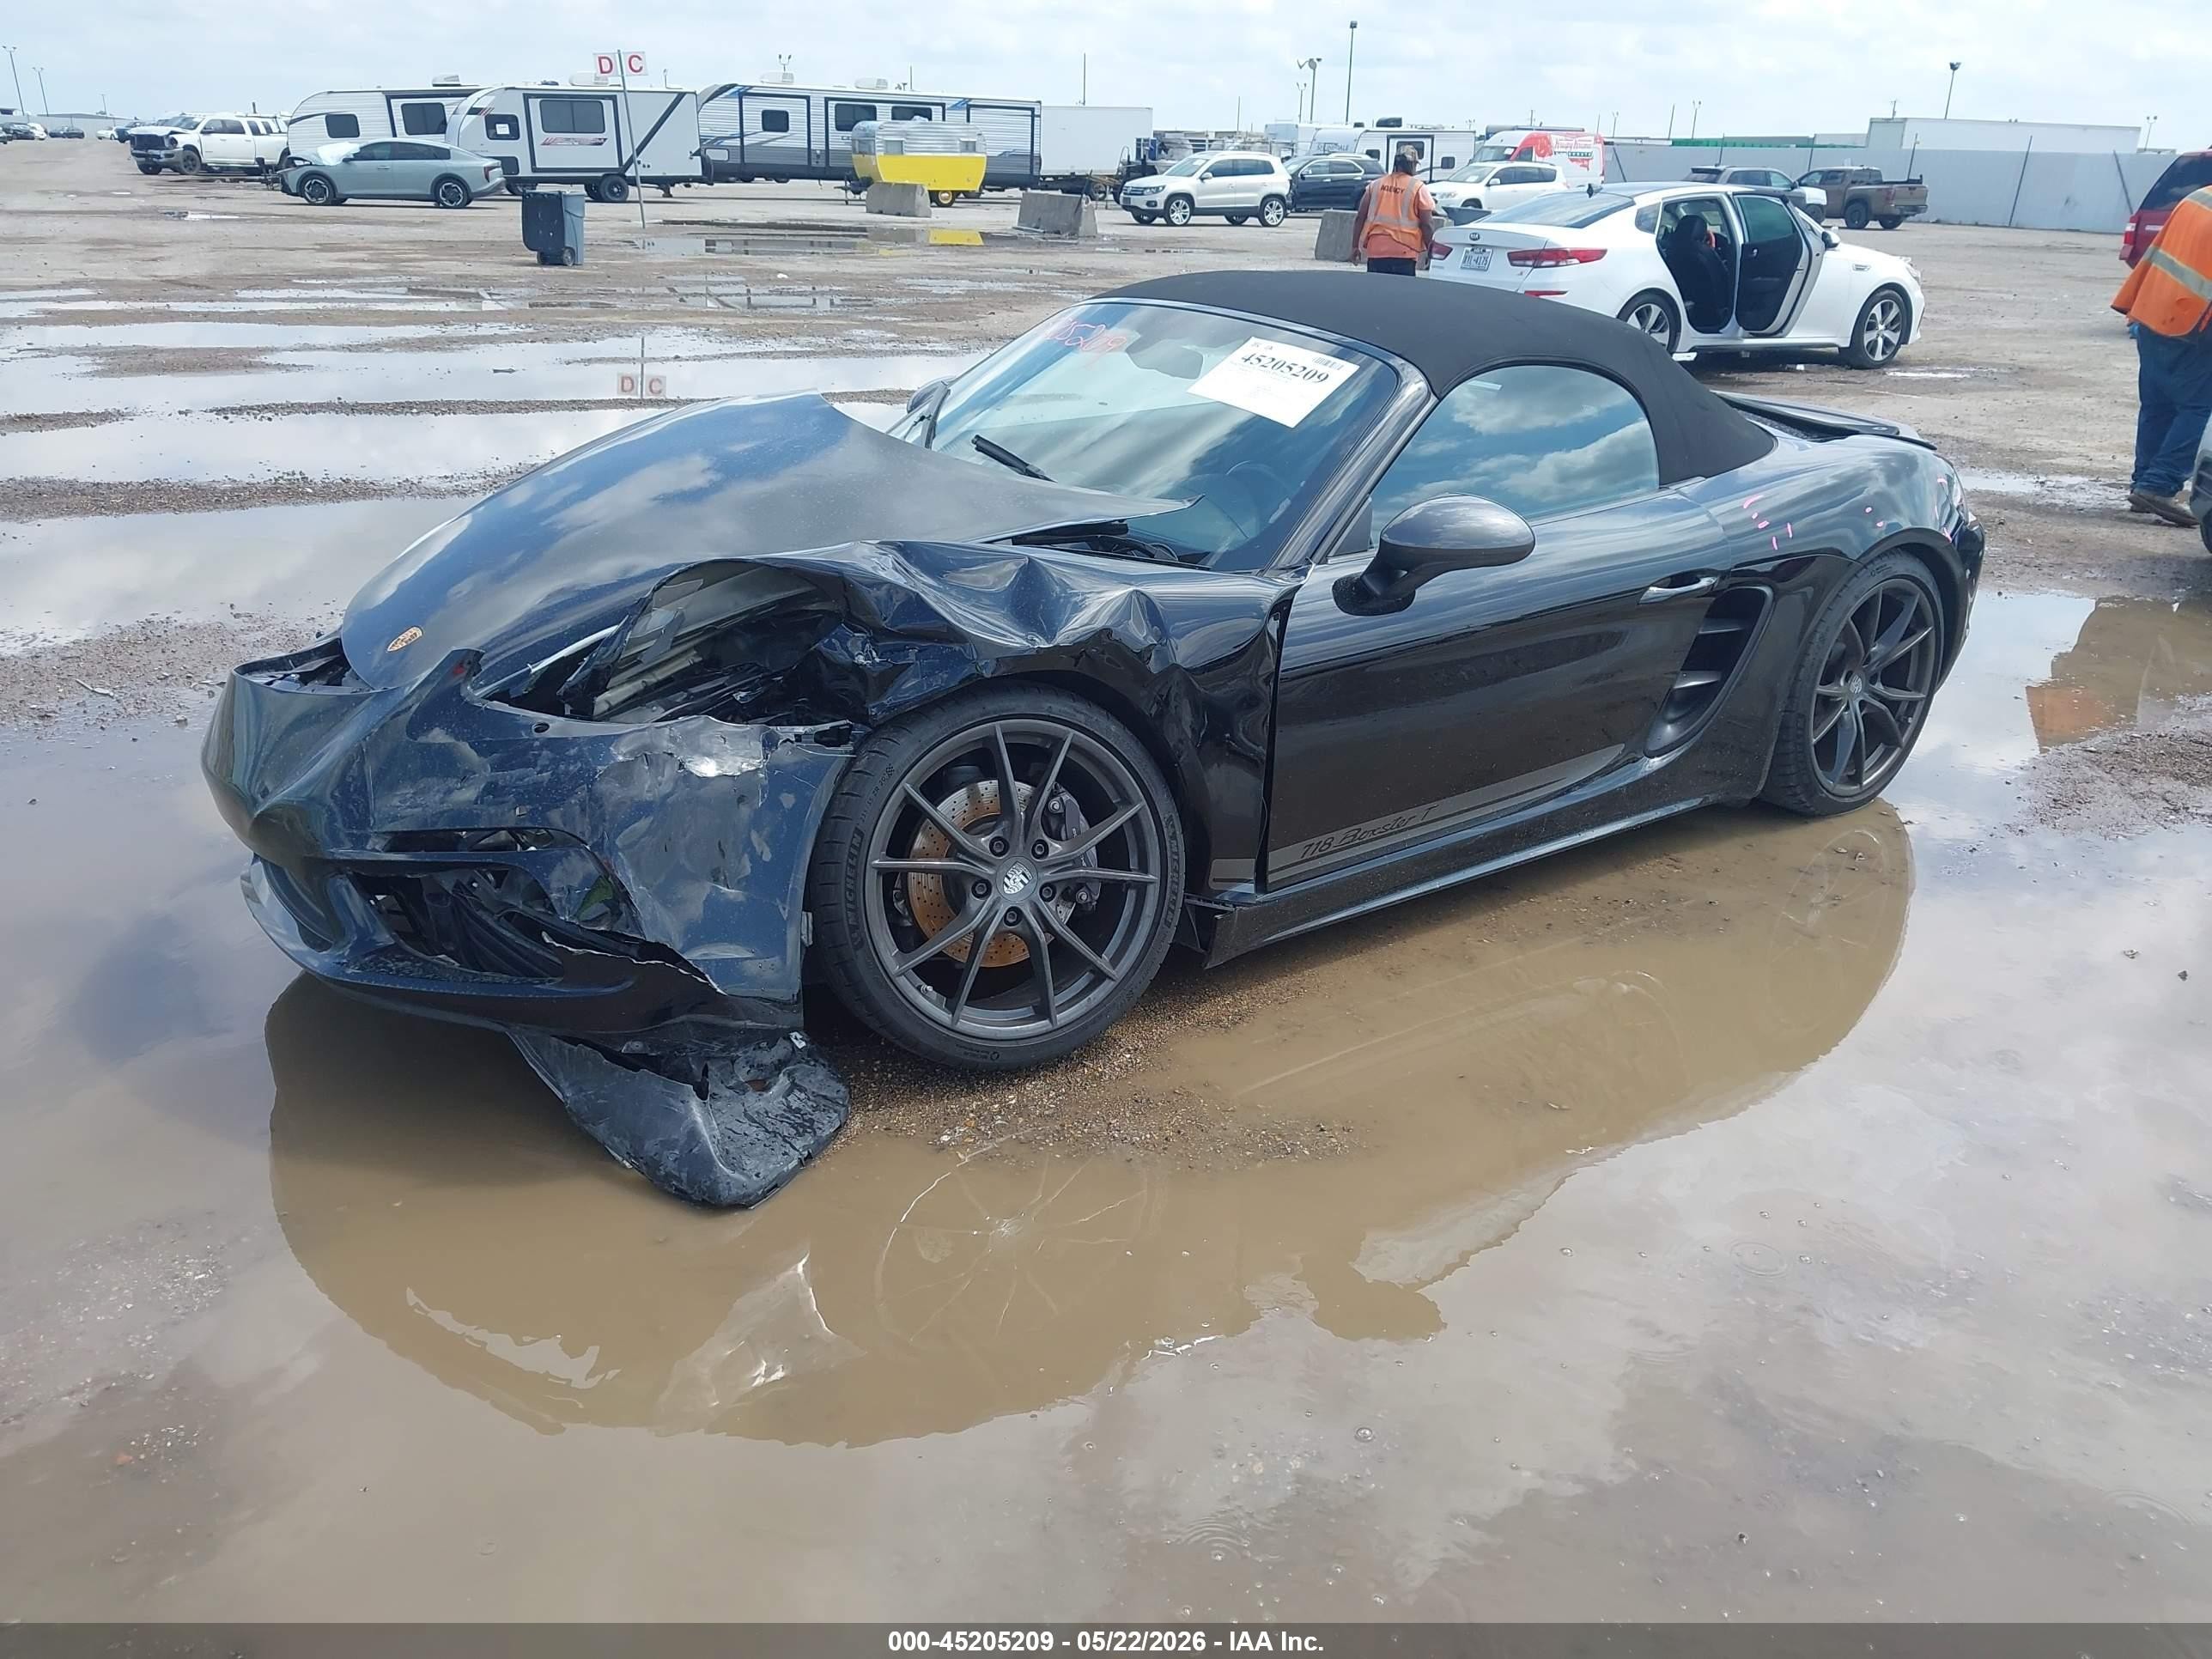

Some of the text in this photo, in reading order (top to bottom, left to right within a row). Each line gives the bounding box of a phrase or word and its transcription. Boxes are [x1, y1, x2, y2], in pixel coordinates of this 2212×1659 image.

[598, 56, 614, 75] D
[628, 54, 643, 73] C
[1380, 185, 1406, 194] AGENCY
[1241, 353, 1329, 384] 45205209
[1300, 804, 1439, 859] 718 Boxster T
